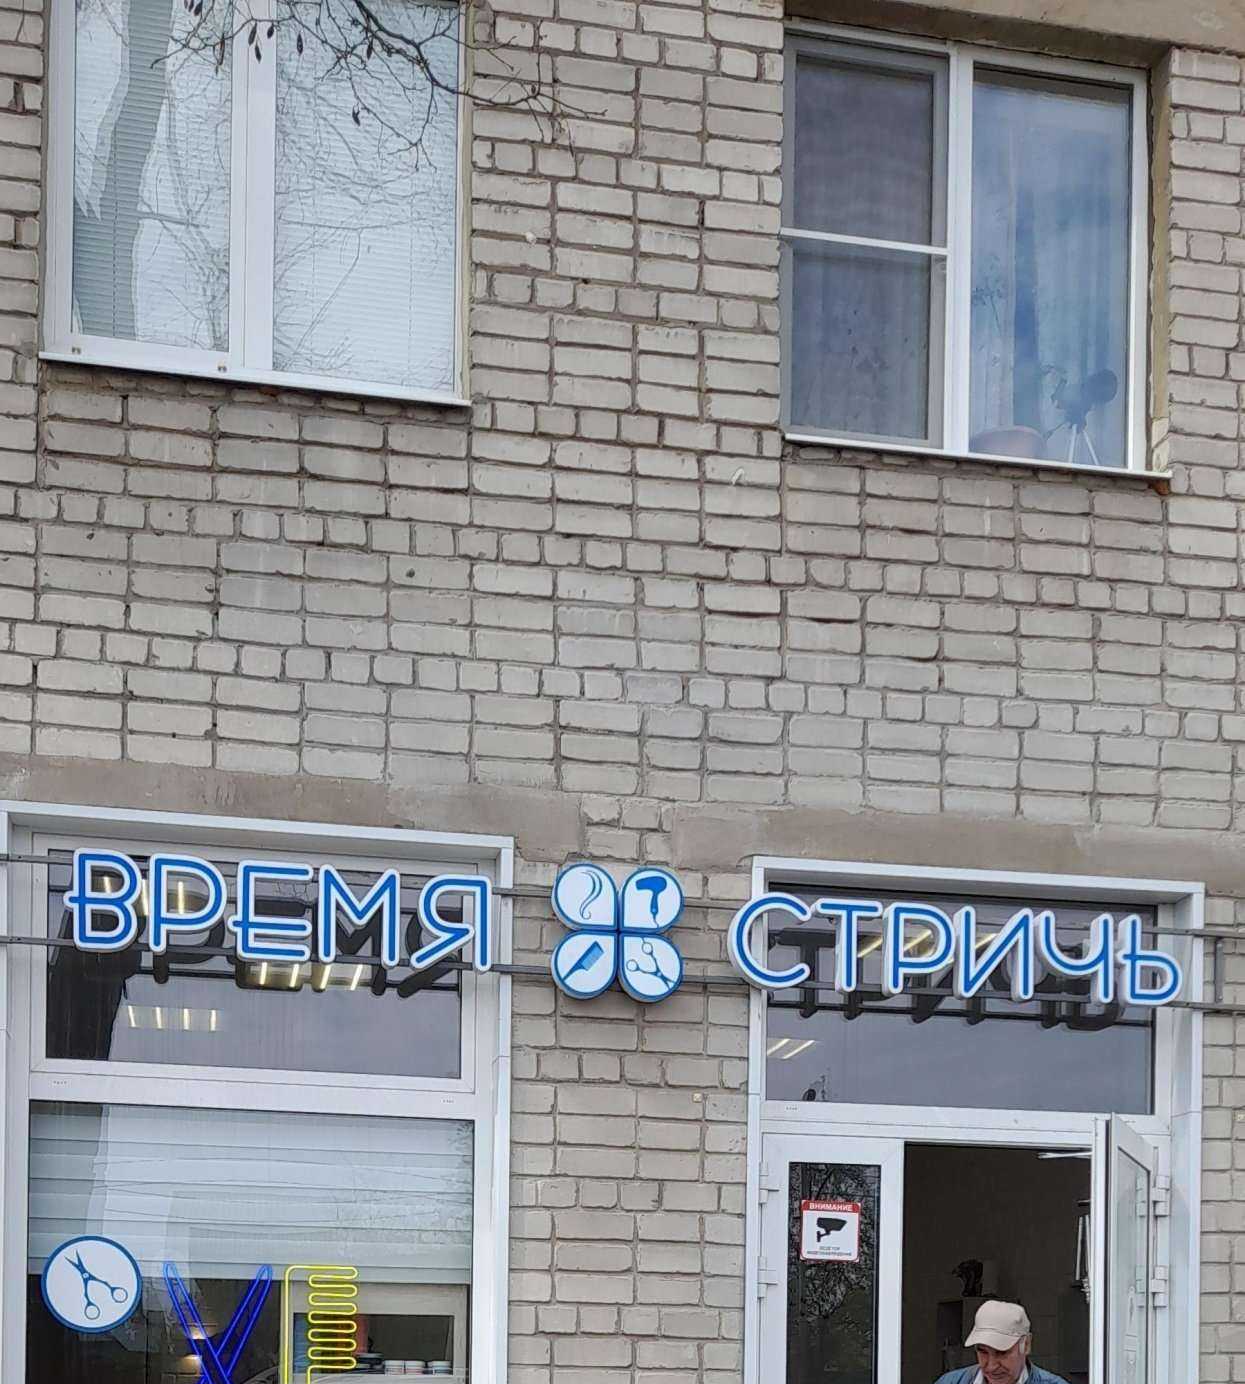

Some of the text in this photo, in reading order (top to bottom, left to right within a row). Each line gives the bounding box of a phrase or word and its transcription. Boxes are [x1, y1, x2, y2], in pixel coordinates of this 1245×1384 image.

[64, 848, 1183, 1006] ВРЕМЯ СТРИЧЬ
[809, 1202, 854, 1212] ВНИМАНИЕ
